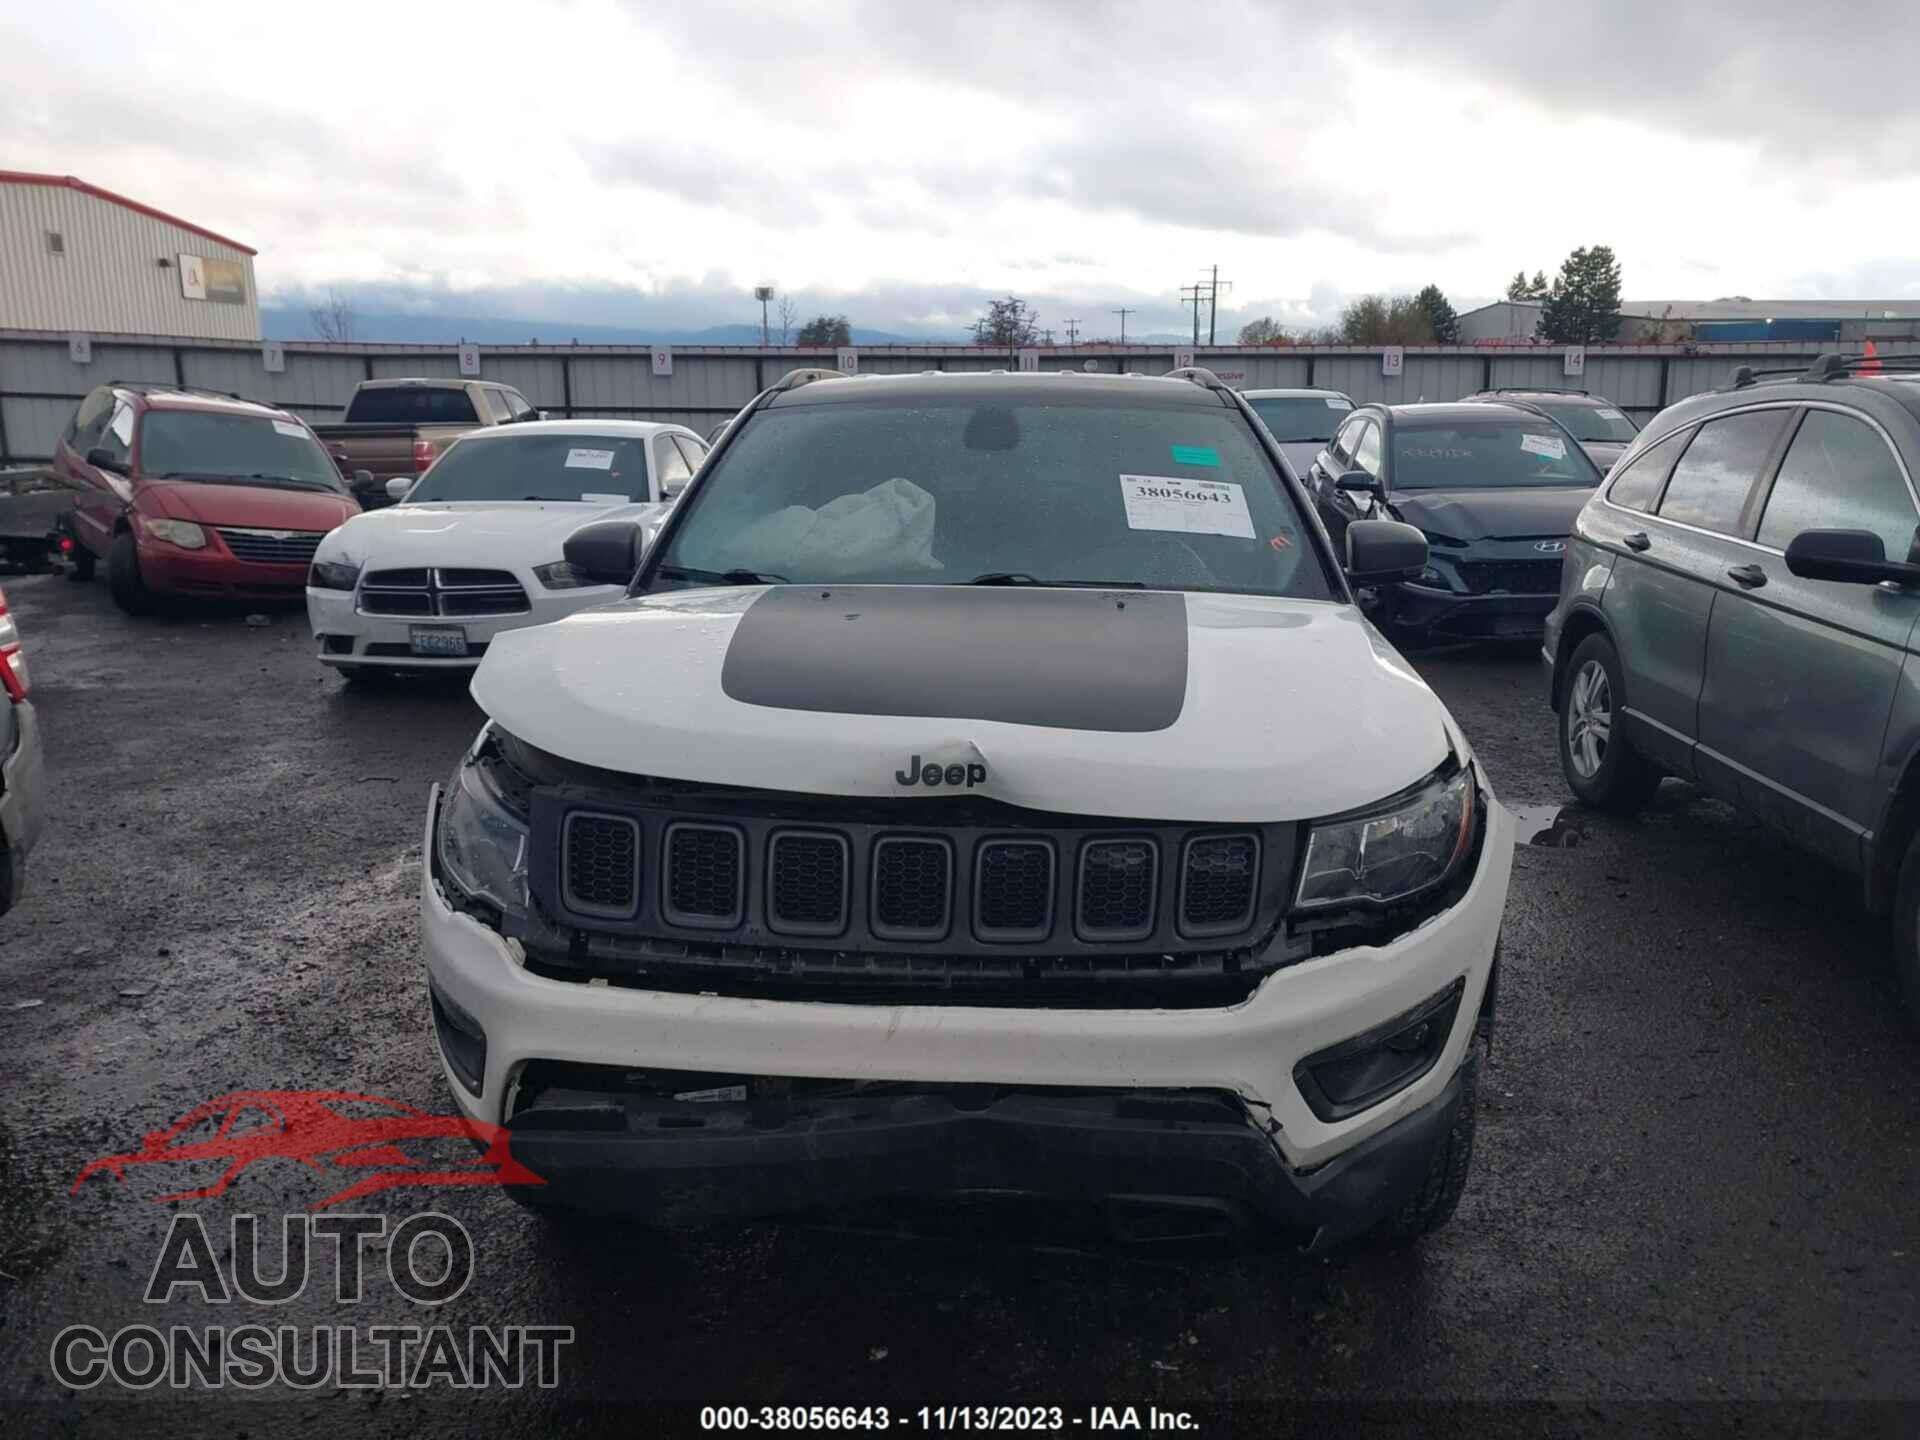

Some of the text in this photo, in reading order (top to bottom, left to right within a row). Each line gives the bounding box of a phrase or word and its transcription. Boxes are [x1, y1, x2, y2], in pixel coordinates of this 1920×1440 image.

[464, 352, 474, 367] 8
[657, 352, 667, 367] 9
[841, 355, 855, 369] 10
[1177, 354, 1192, 367] 12
[1386, 353, 1400, 368] 13
[1567, 353, 1582, 367] 14
[1135, 485, 1232, 504] 38056643
[895, 754, 987, 788] Jeep
